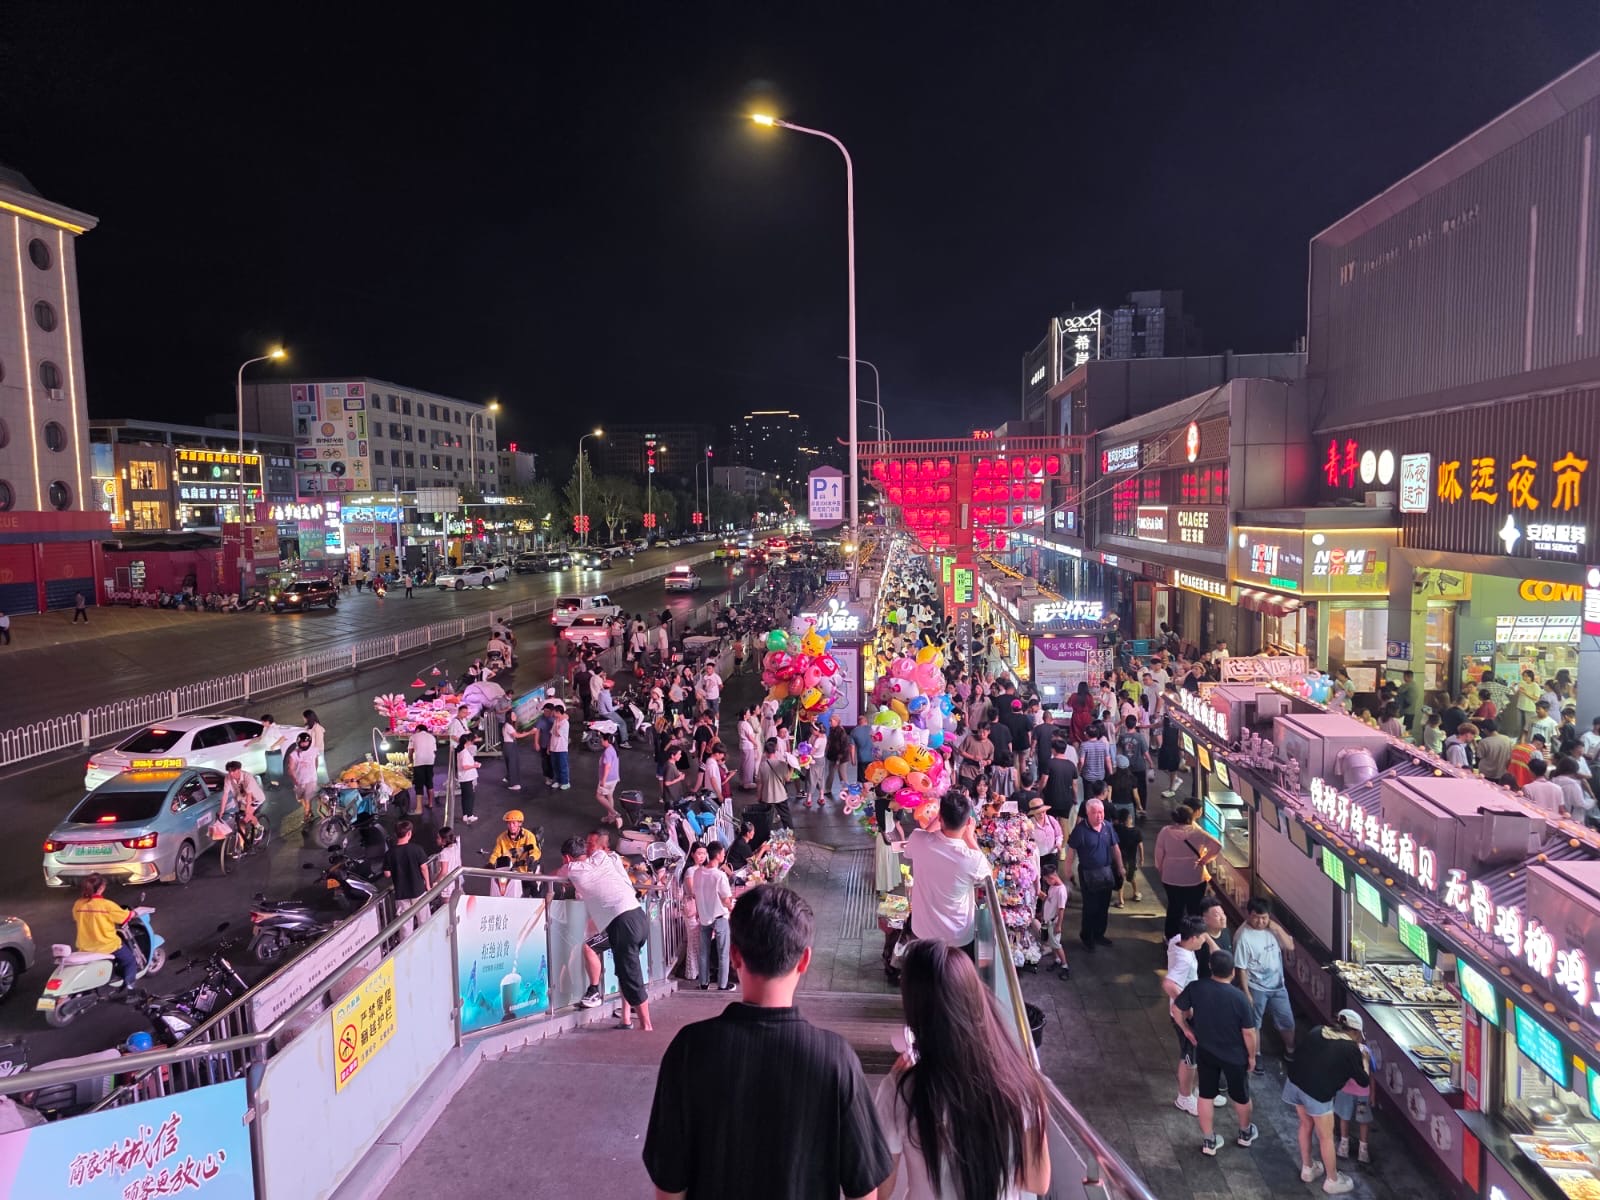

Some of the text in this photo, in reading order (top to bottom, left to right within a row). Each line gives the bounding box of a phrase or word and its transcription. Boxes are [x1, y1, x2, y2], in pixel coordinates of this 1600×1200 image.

[813, 478, 827, 499] P
[1437, 451, 1589, 511] 怀远夜市
[1178, 511, 1209, 528] CHAGEE
[480, 914, 509, 932] 珍惜粮食
[481, 940, 510, 960] 拒绝浪费
[360, 987, 392, 1029] 严禁攀爬
[360, 1005, 393, 1046] 翻越护栏
[69, 1113, 181, 1185] 商家讲诚信
